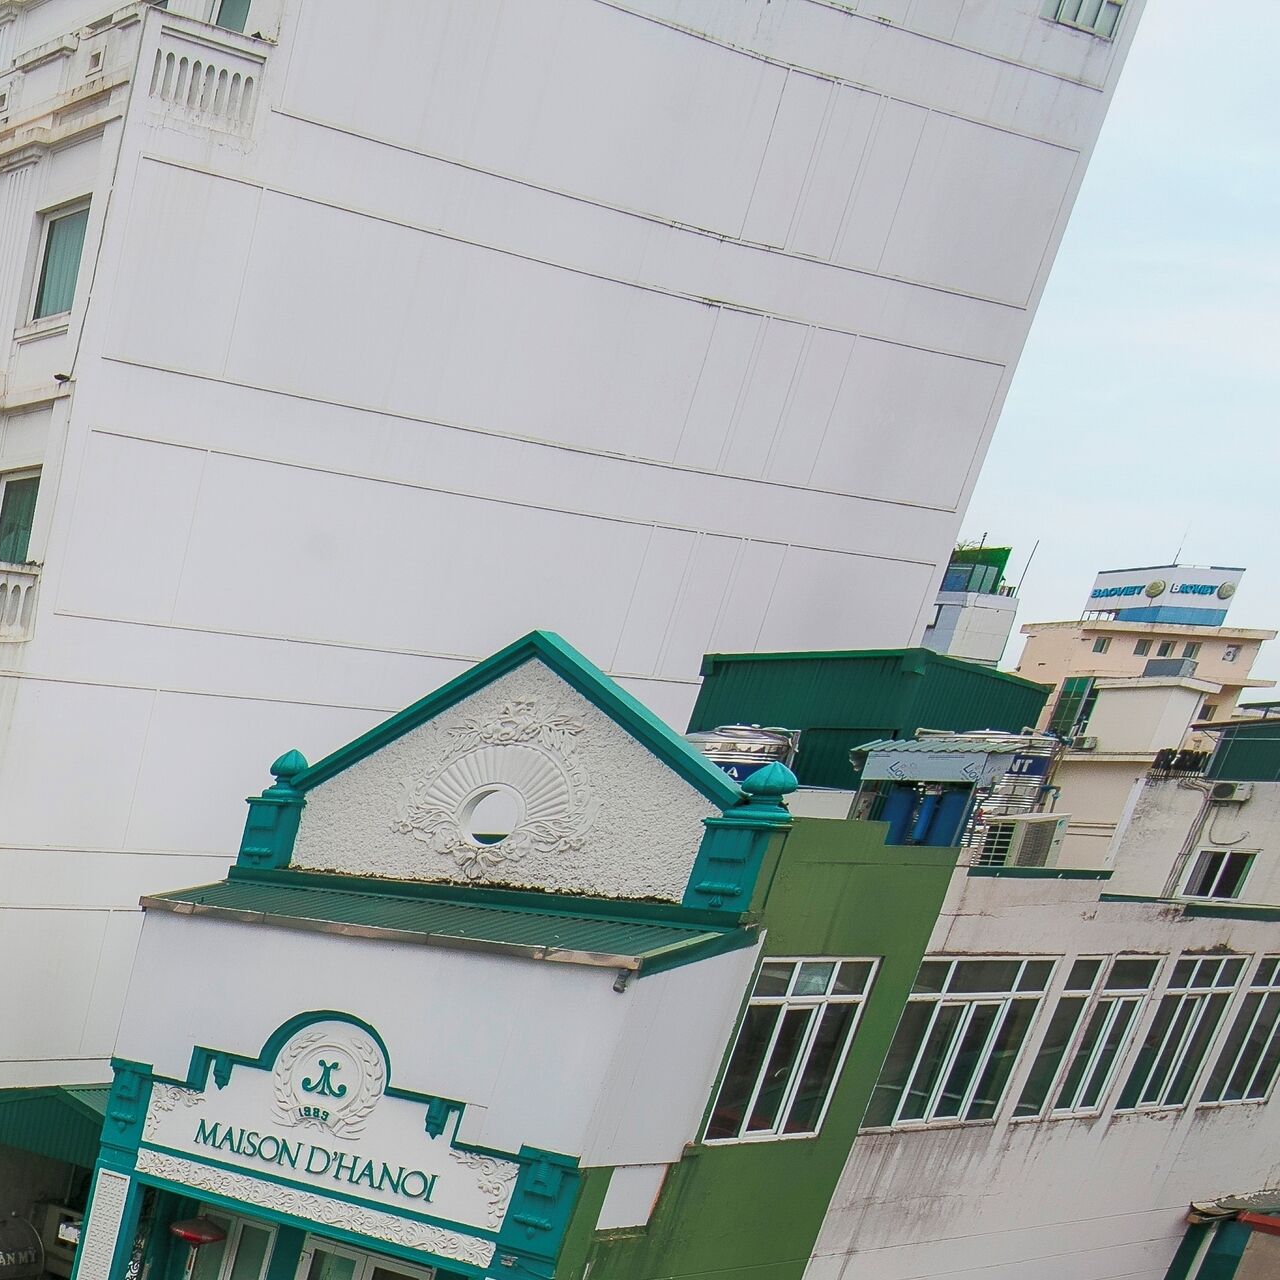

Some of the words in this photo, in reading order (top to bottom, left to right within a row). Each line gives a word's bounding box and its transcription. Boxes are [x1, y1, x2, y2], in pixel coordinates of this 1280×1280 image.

[298, 1106, 330, 1121] 1989
[193, 1118, 304, 1169] MAISON
[304, 1145, 439, 1203] D'HANOI
